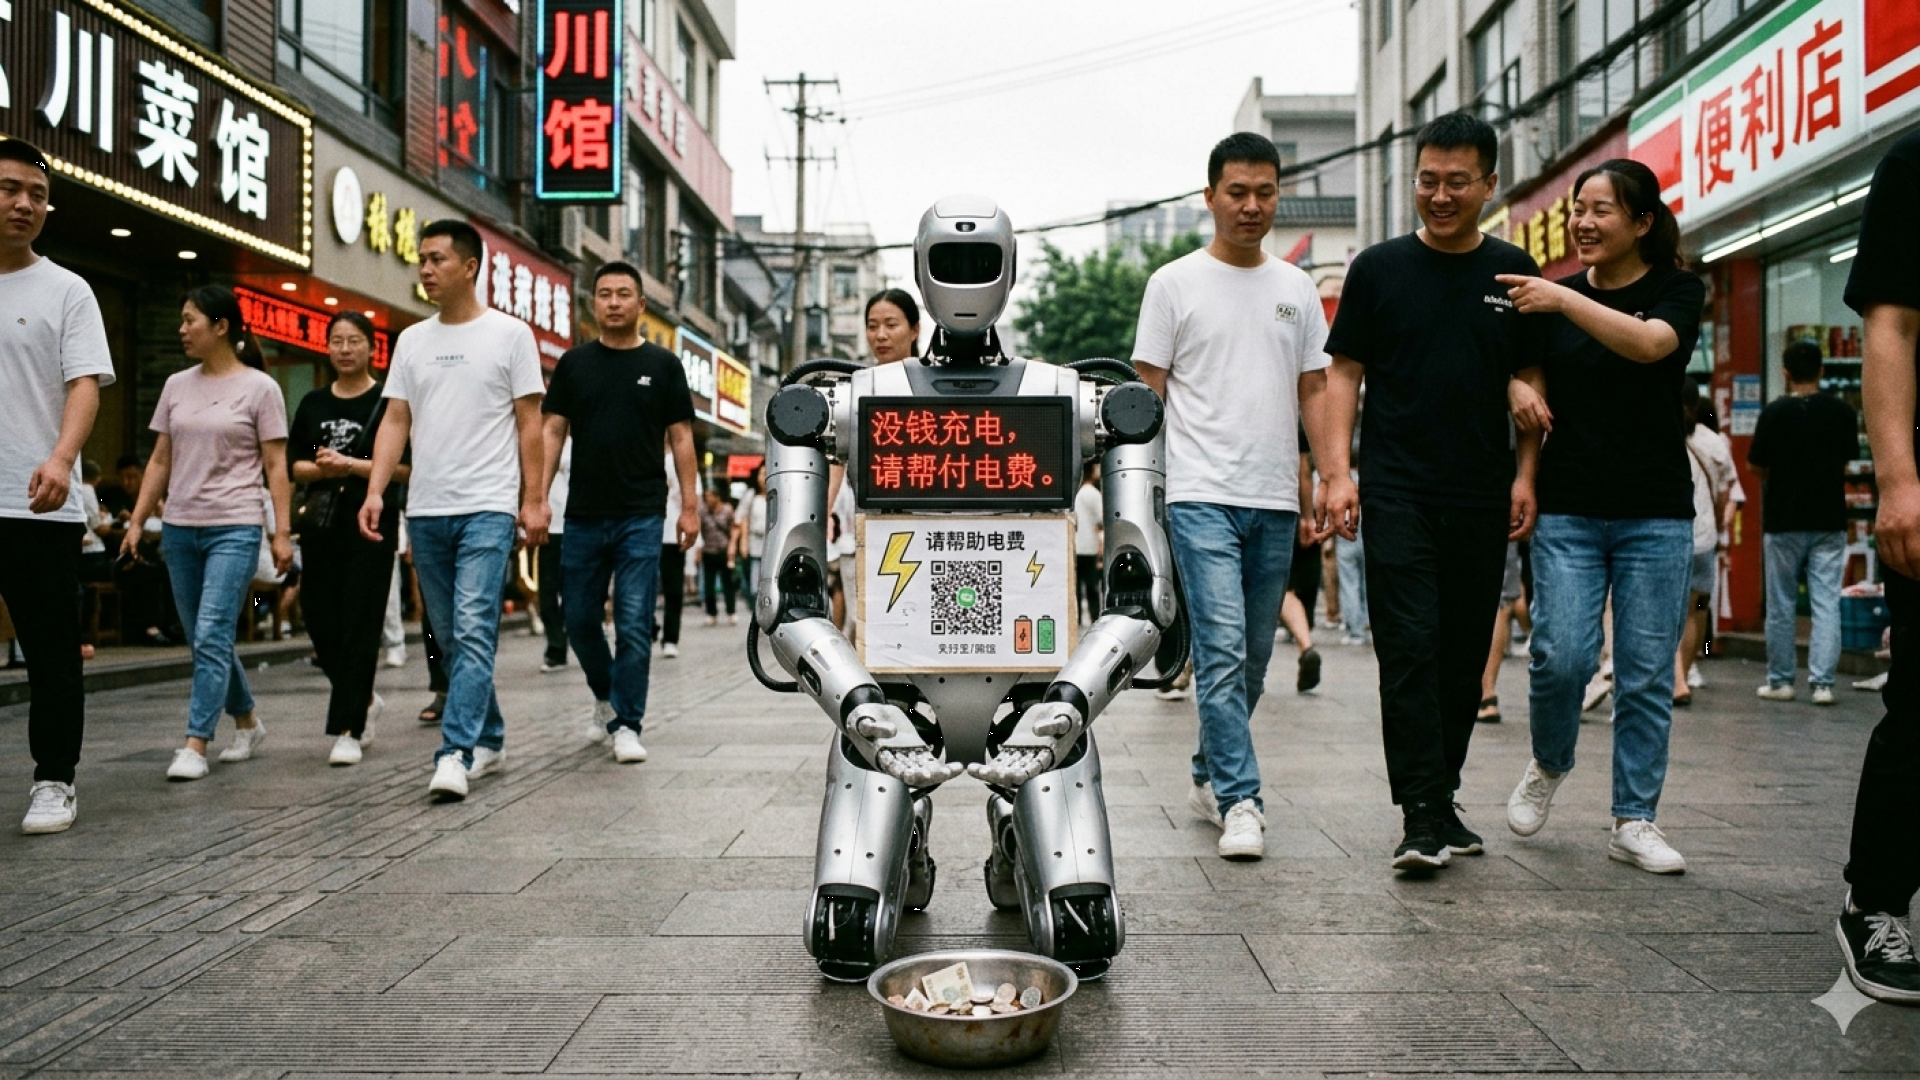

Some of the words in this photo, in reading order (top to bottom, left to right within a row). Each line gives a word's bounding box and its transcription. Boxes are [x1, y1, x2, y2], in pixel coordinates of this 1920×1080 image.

[0, 0, 271, 221] 川菜馆
[544, 9, 613, 170] 川馆
[1694, 18, 1843, 198] 便利店
[870, 452, 1053, 490] 请帮付电费。
